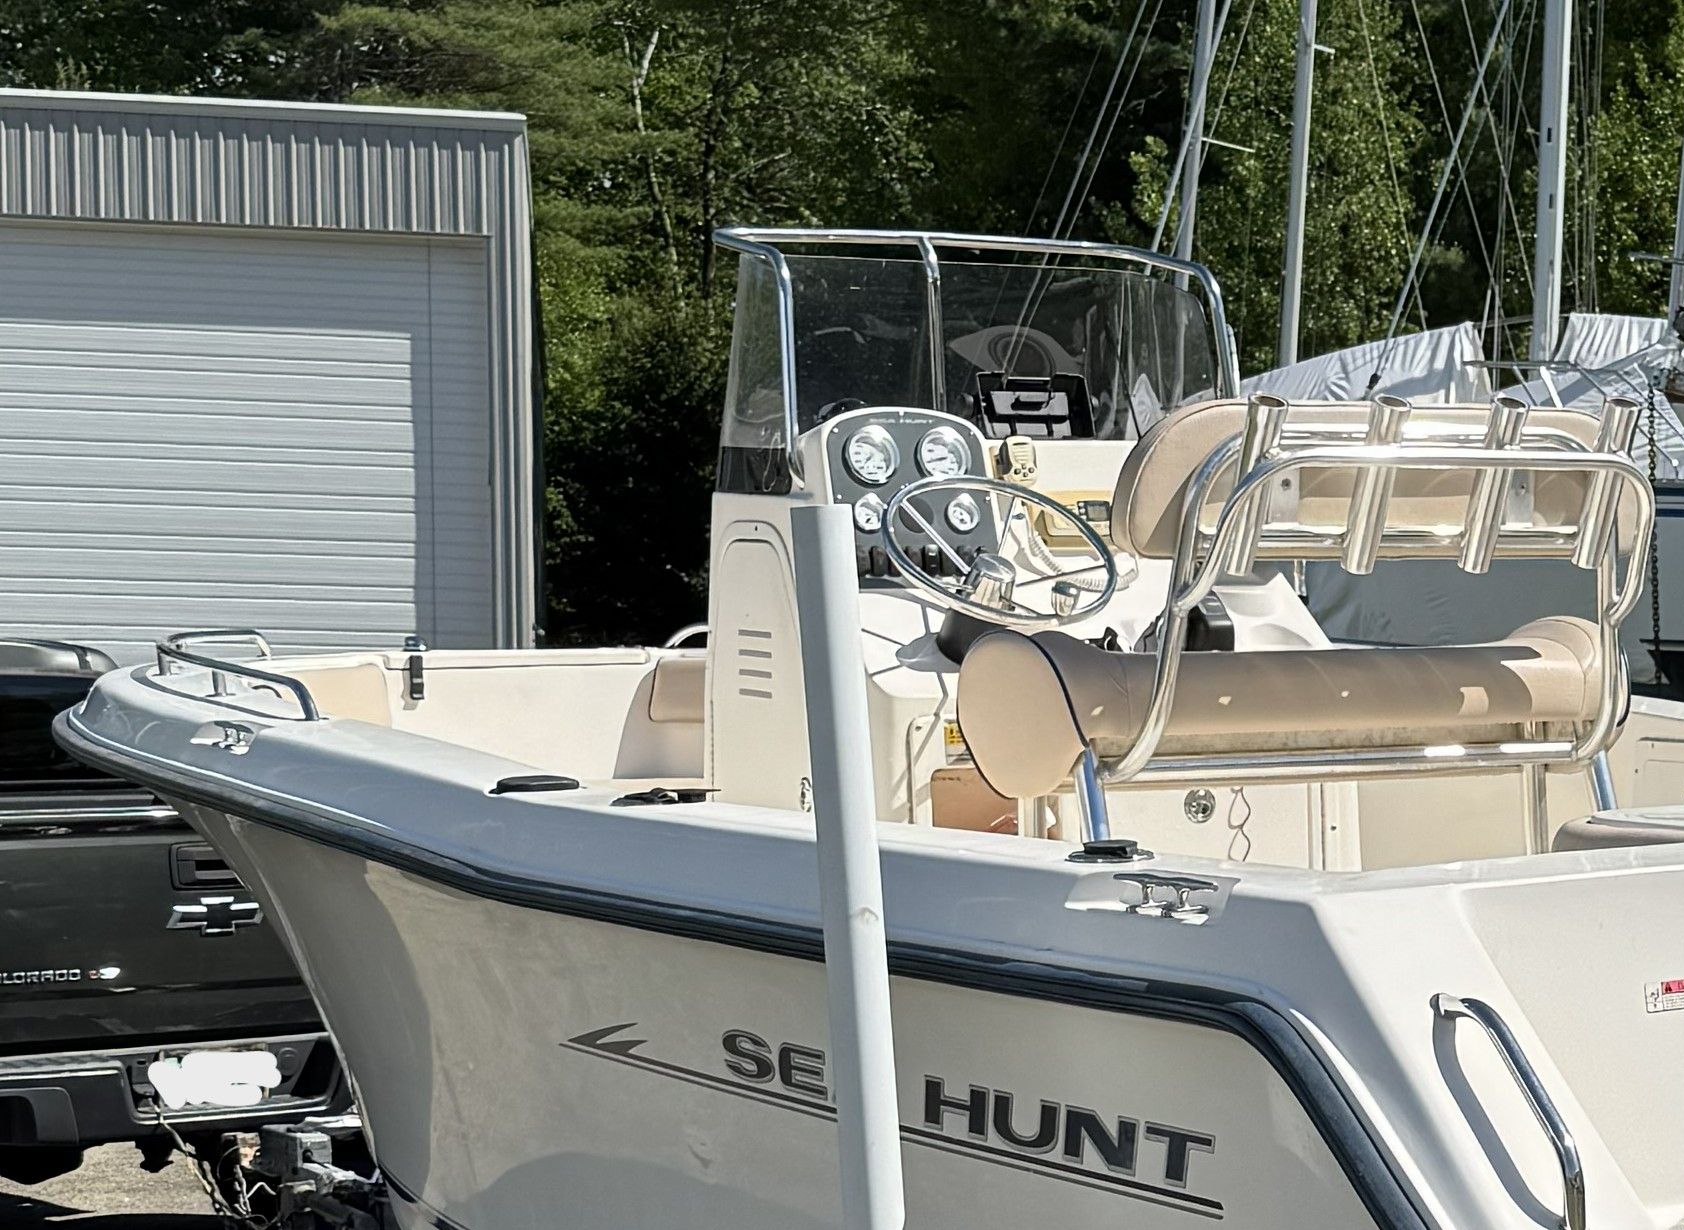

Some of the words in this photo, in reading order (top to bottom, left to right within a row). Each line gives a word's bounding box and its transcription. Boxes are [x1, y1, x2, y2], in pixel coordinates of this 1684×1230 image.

[0, 969, 82, 984] LORADO
[721, 1027, 836, 1104] SE
[923, 1074, 1216, 1187] HUNT
